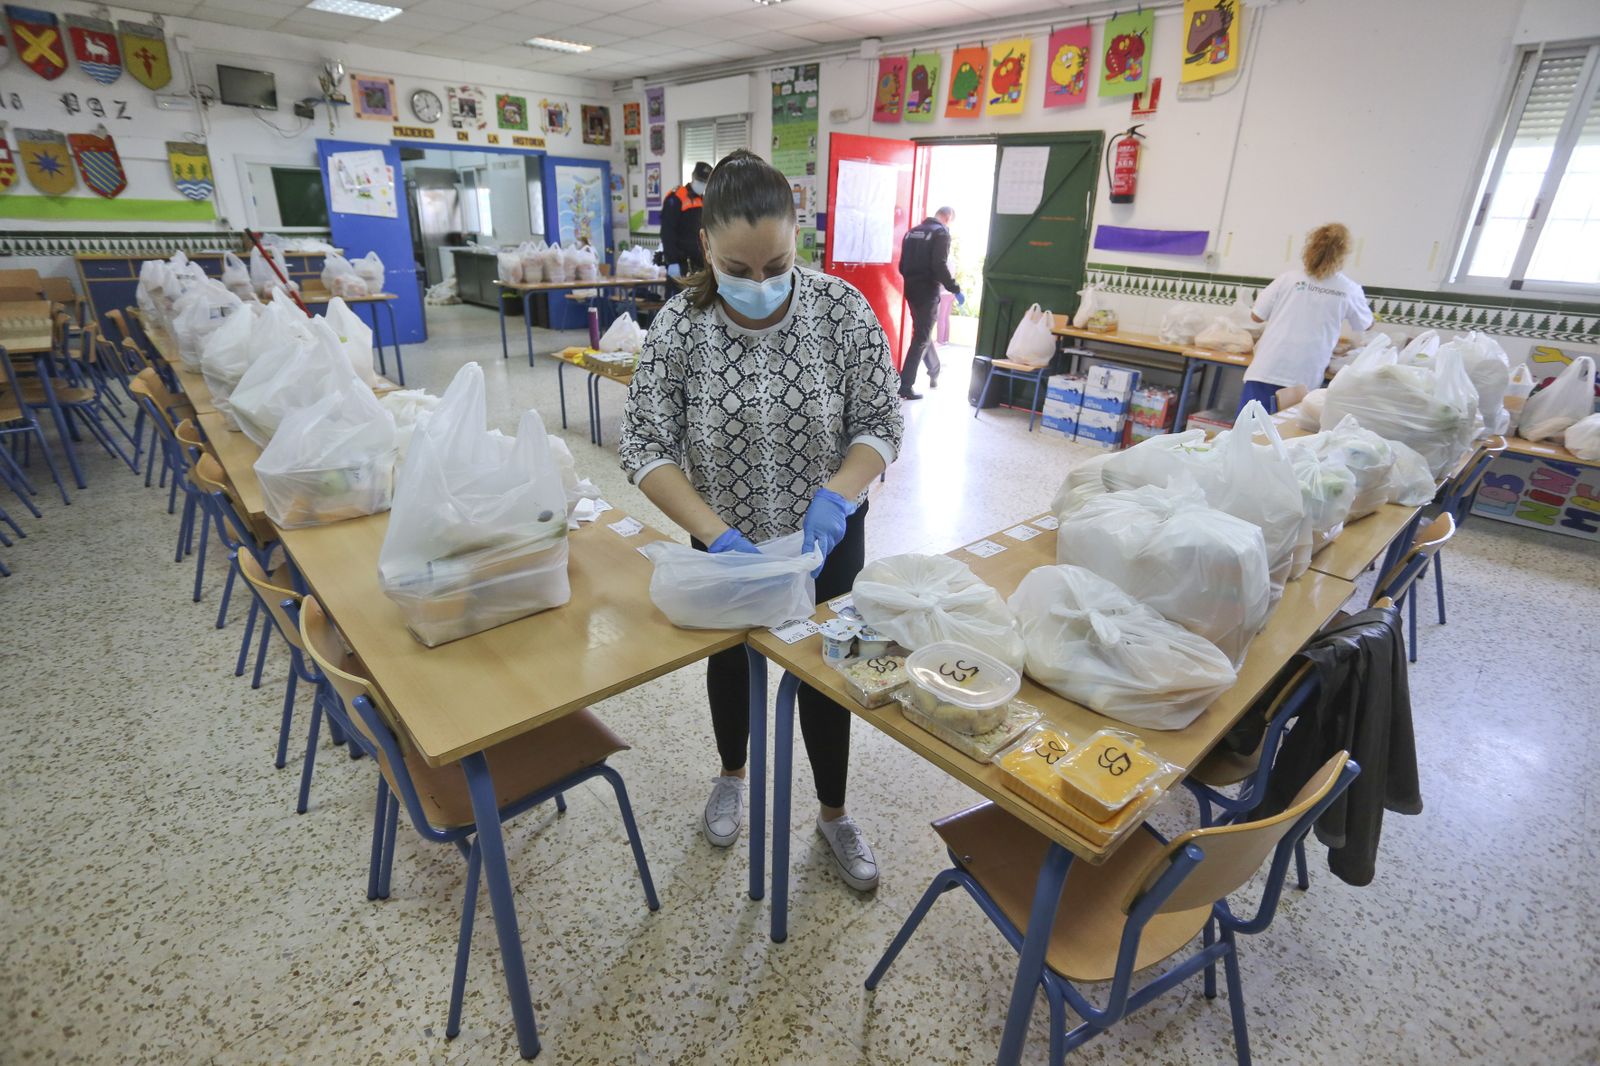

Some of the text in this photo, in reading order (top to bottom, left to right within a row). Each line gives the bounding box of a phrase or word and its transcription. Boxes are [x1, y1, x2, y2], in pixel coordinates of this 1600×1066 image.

[1476, 472, 1524, 516] LOS
[867, 658, 898, 674] 53
[939, 659, 981, 683] 53
[1097, 745, 1132, 776] 53
